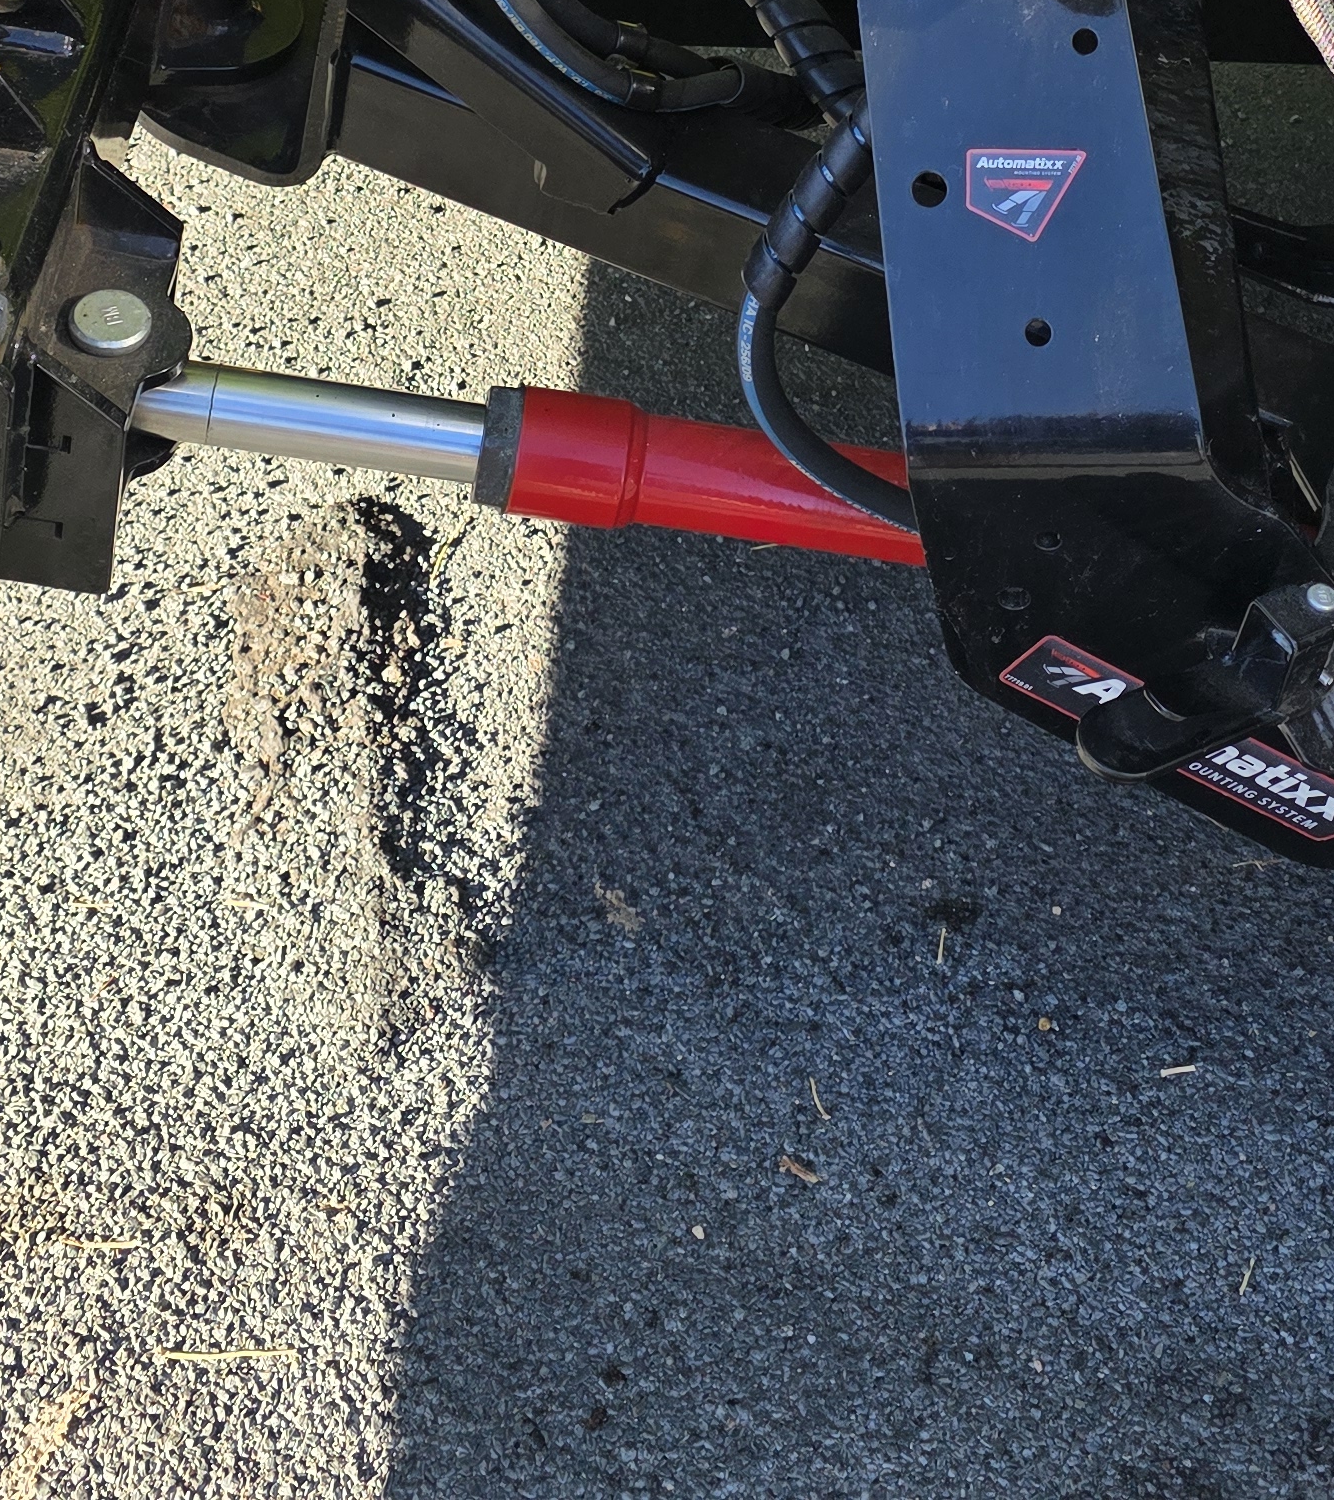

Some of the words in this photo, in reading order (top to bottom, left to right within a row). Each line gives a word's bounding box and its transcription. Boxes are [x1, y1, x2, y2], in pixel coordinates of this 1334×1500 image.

[976, 156, 1064, 170] Automatixx
[1188, 761, 1258, 800] OUNTING
[1257, 796, 1319, 830] SYSTEM
